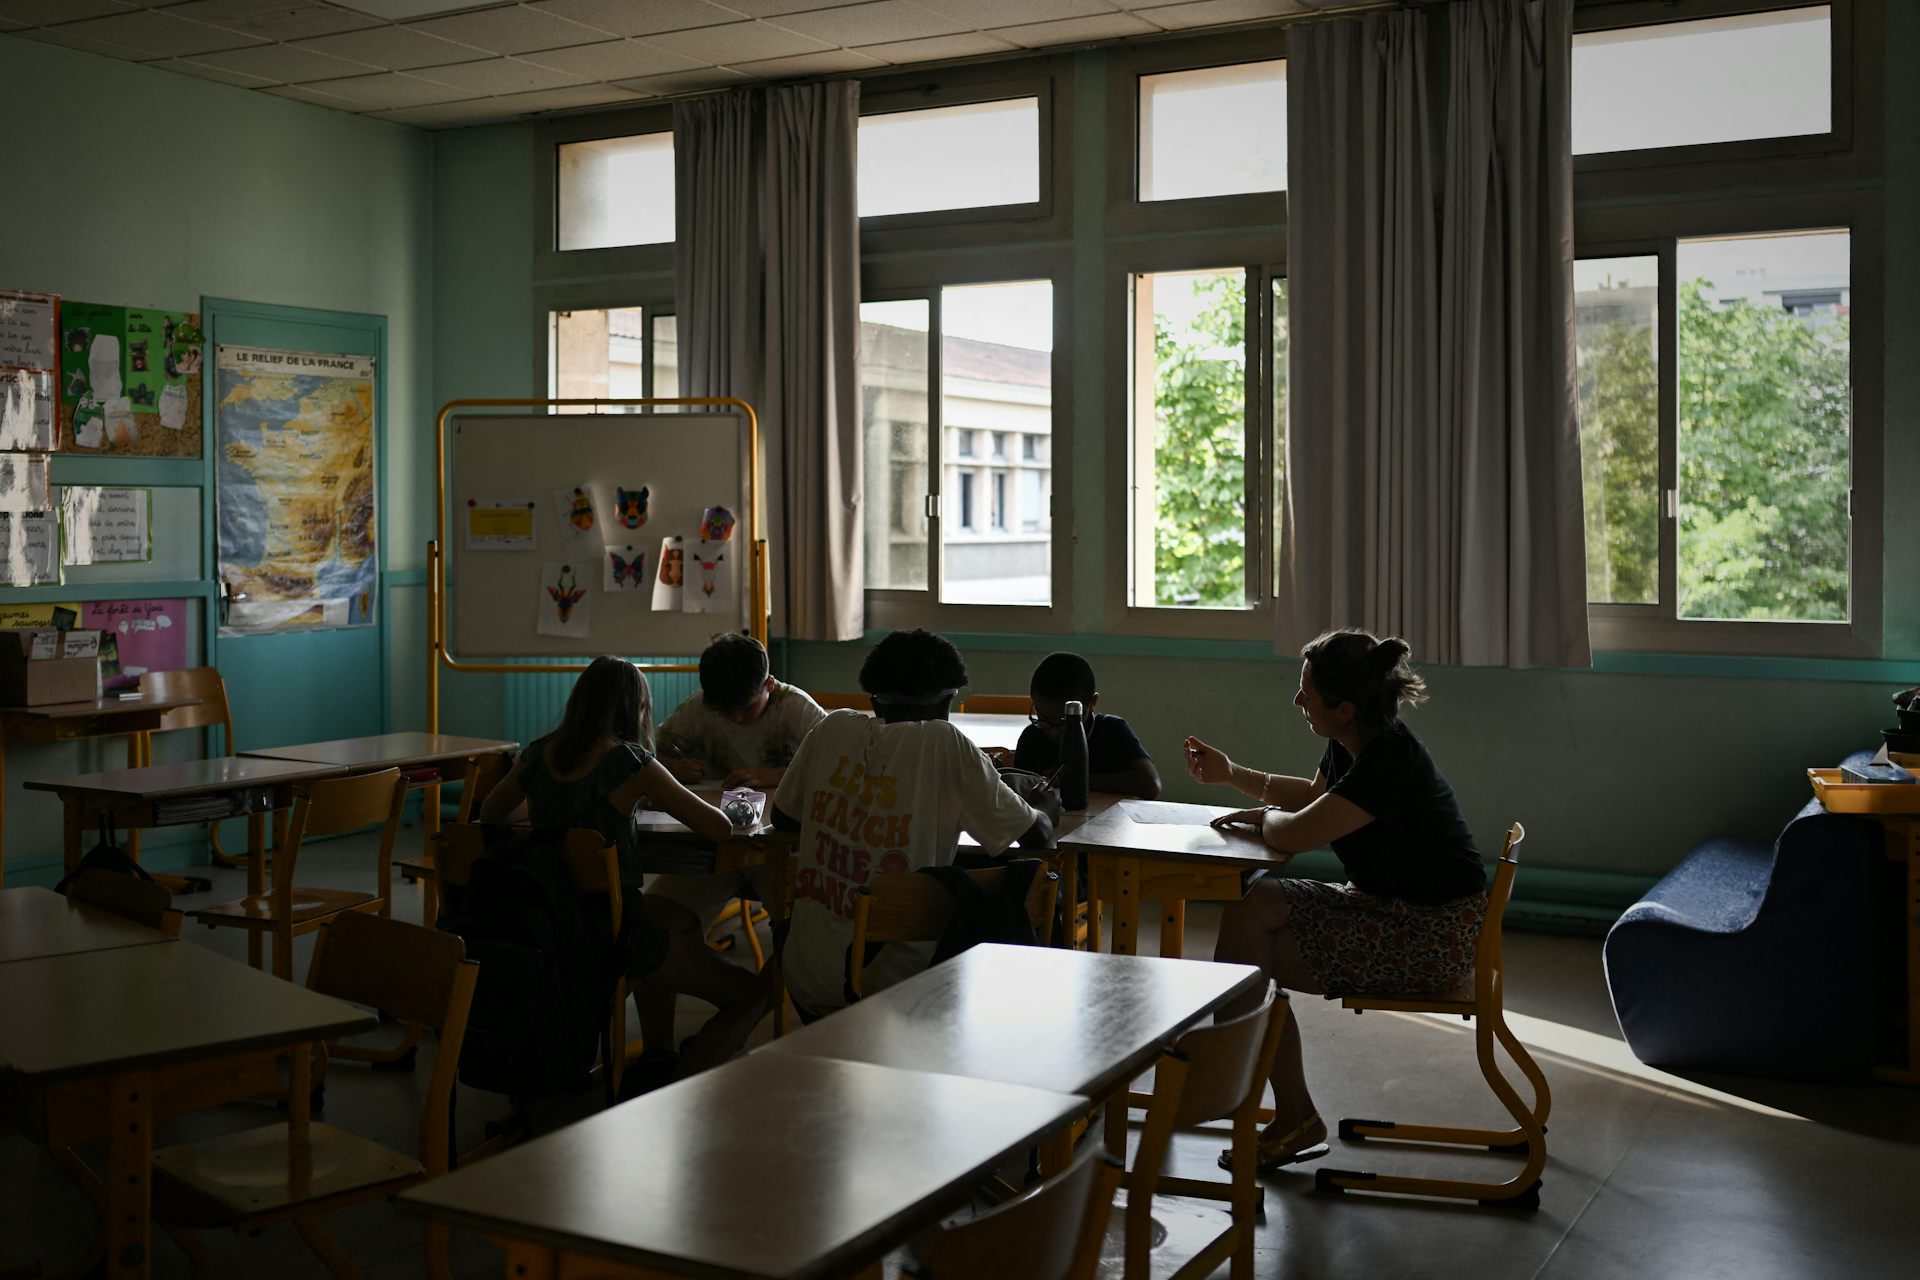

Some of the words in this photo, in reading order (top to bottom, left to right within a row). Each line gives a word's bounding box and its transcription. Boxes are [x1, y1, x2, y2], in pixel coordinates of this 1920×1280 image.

[236, 352, 249, 362] LE
[252, 353, 283, 364] RELIEF
[286, 356, 299, 366] DE
[302, 357, 315, 367] LA
[318, 359, 355, 370] FRANCE
[810, 790, 913, 848] WATCH
[815, 830, 872, 884] THE
[796, 868, 859, 920] SUNS
